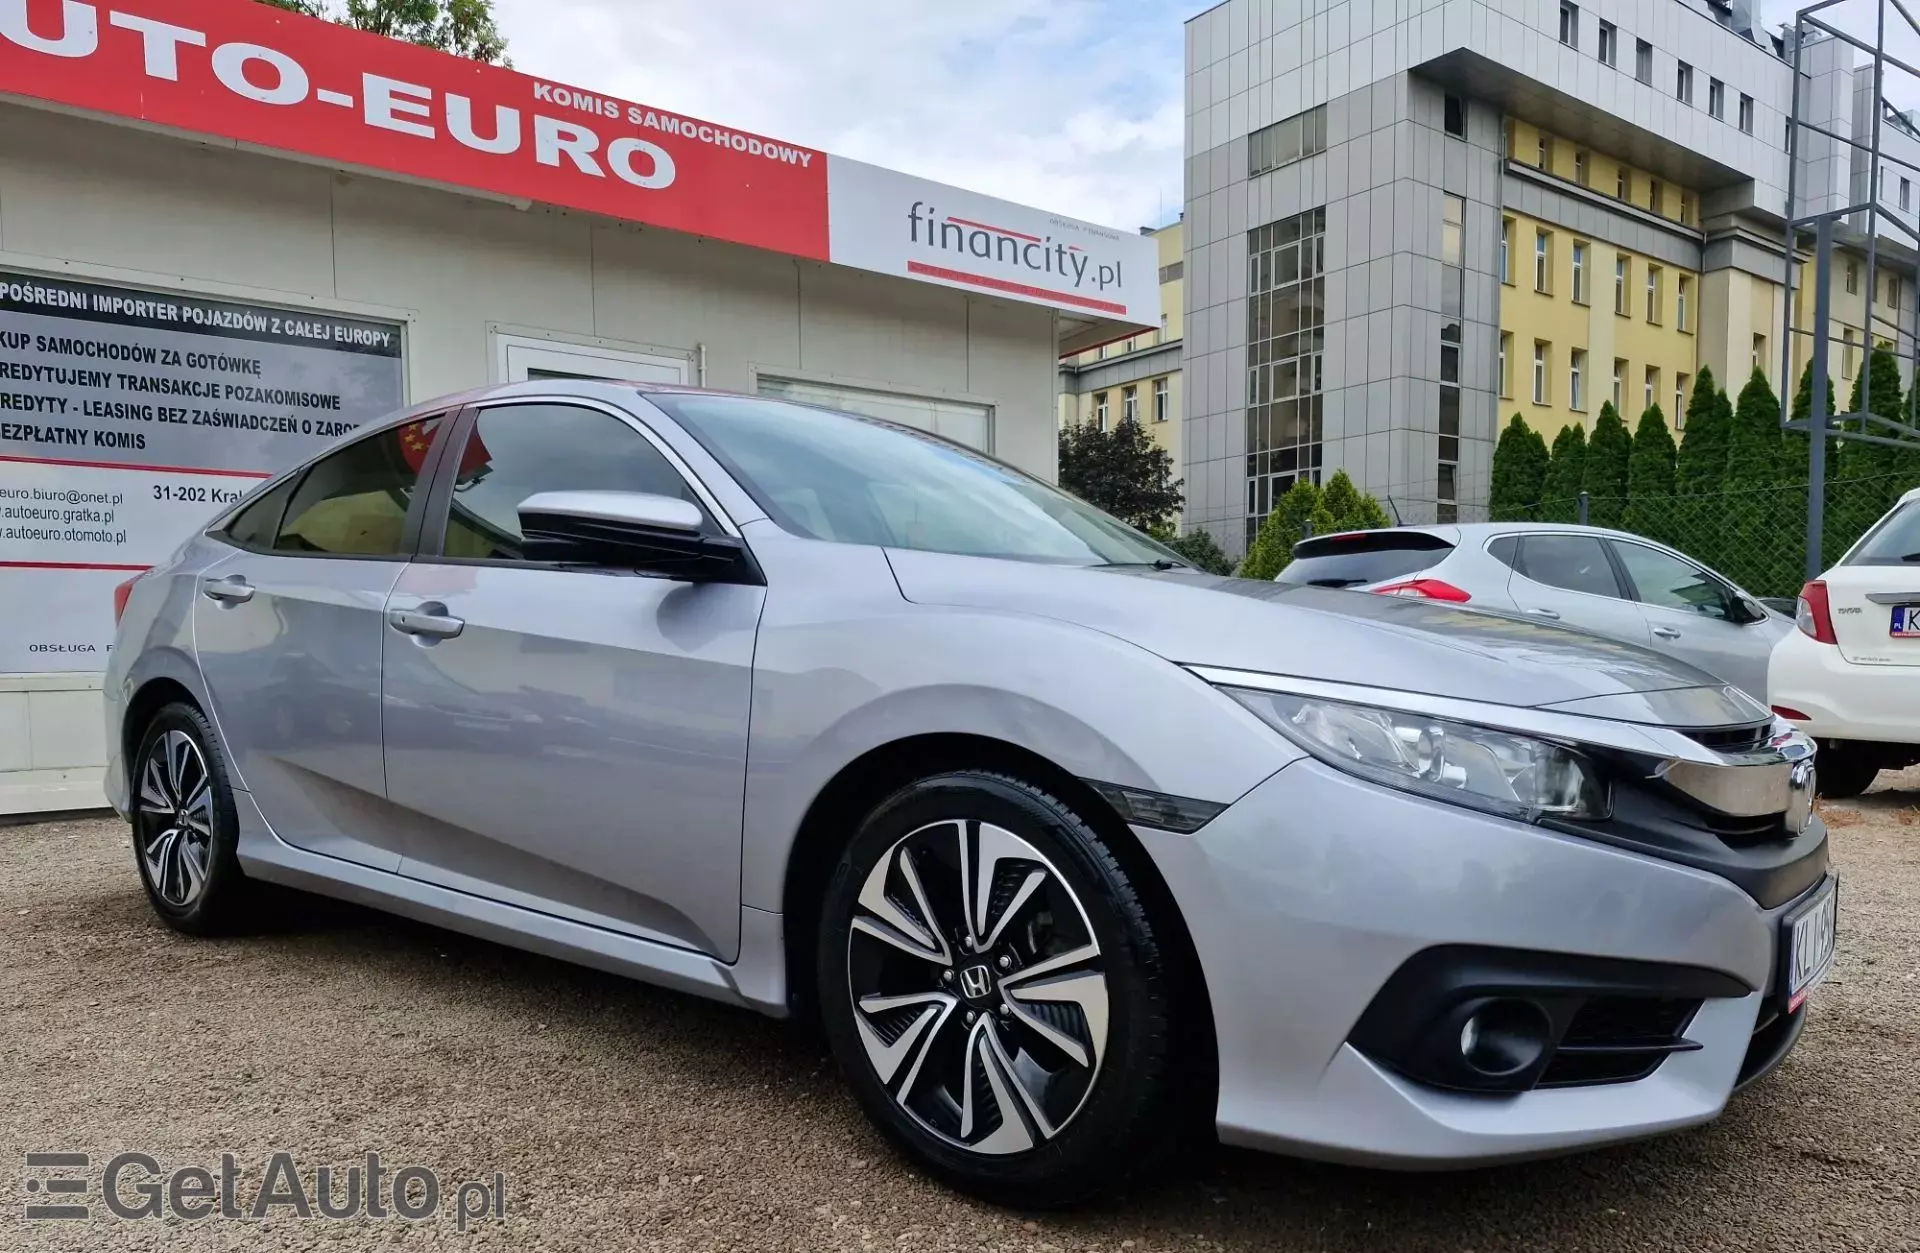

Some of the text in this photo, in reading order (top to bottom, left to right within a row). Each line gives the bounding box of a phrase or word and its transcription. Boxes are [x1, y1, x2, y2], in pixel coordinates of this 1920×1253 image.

[533, 81, 812, 168] KOMIS SAMOCHODOWY
[907, 201, 1122, 291] financity.pl
[0, 281, 391, 348] POŚREDNI IMPORTER POJAZDÓW Z CAŁEJ EUROPY
[36, 334, 156, 365] SAMOCHODÓW
[161, 350, 181, 367] ZA
[186, 350, 262, 379] GOTÓWKĘ
[0, 361, 341, 411] REDYTUJEMY TRANSAKCJE POZAKOMISOWE
[0, 392, 67, 414] REDYTY
[83, 399, 153, 421] LEASING
[158, 408, 188, 424] BEZ
[192, 408, 298, 434] ZAŚWIADCZEŃ
[302, 419, 311, 435] O
[1, 422, 145, 450] EZPŁATNY KOMIS
[0, 488, 123, 505] euro.biuro@onet.pl
[153, 484, 206, 502] 31-202
[0, 505, 114, 524] .autoeuro.gratka.pl
[0, 525, 126, 545] .autoeuro.otomoto.pl
[1893, 622, 1903, 630] PL
[29, 643, 96, 653] OBSŁUGA
